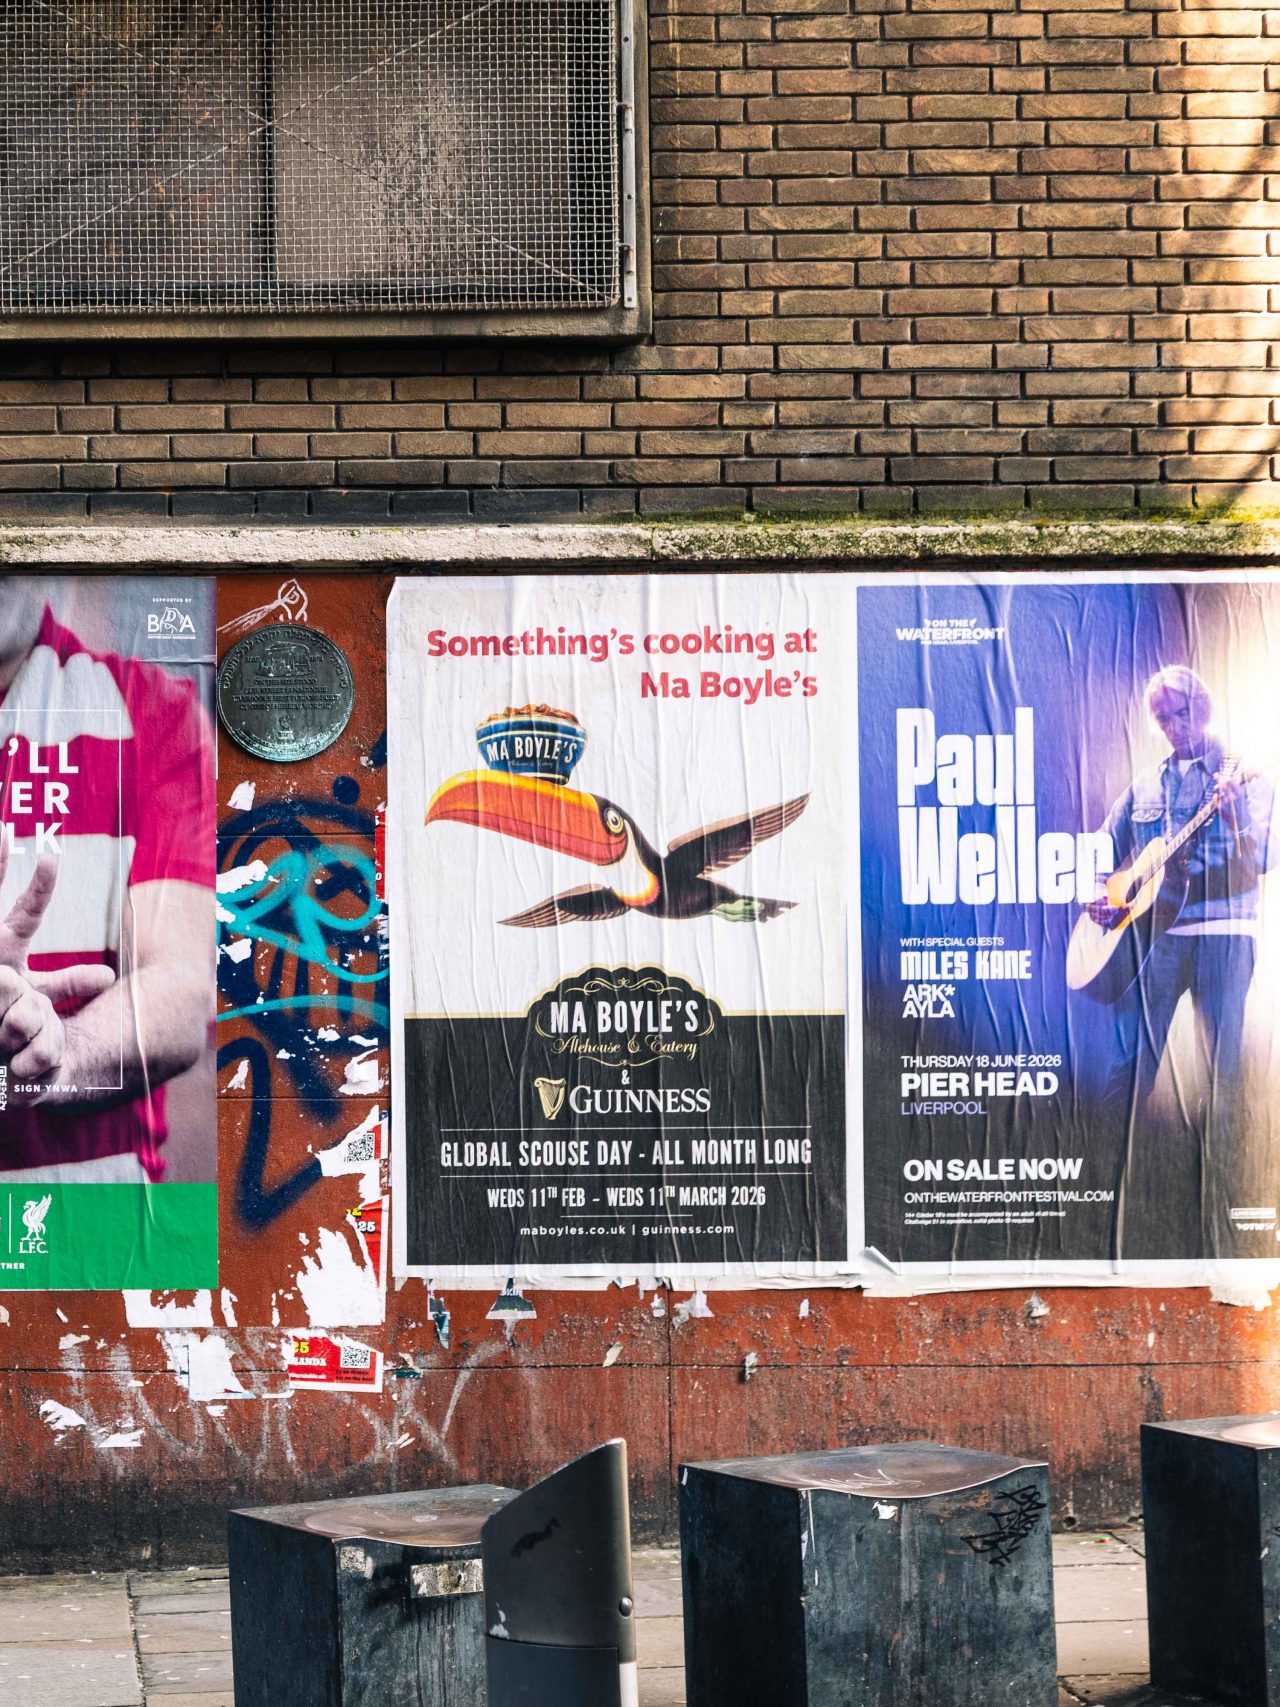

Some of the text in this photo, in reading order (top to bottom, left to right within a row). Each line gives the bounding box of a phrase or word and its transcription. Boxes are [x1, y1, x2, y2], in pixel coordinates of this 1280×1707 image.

[895, 627, 1006, 641] WATERFRONT
[931, 618, 968, 628] ON THE
[427, 625, 818, 662] Something's cooking at
[640, 670, 818, 705] Ma Boyle's
[486, 736, 577, 764] MA BOYLE'S
[896, 706, 1035, 806] Paul
[897, 805, 1114, 905] Weller
[900, 937, 1005, 947] WITH SPECIAL GUESTS
[900, 950, 1032, 981] MILES KANE
[550, 1000, 699, 1033] MA BOYLE'S
[902, 1000, 955, 1019] AYLA
[551, 1035, 621, 1054] Alehouse
[645, 1034, 698, 1061] Eatery
[901, 1054, 1062, 1068] THURSDAY 18 JUNE 2026
[13, 1084, 41, 1093] SIGN
[45, 1084, 78, 1093] YNWA
[621, 1069, 630, 1085] &
[901, 1072, 1059, 1098] PIER HEAD
[569, 1085, 711, 1114] GUINNESS
[901, 1101, 988, 1116] LIVERPOOL
[440, 1141, 512, 1167] GLOBAL
[518, 1140, 590, 1166] SCOUSE
[597, 1140, 633, 1166] DAY
[652, 1140, 685, 1165] ALL
[691, 1139, 756, 1165] MONTH
[763, 1139, 812, 1164] LONG
[903, 1158, 1083, 1181] ON SALE NOW
[487, 1188, 525, 1208] WEDS
[531, 1186, 558, 1208] 11TH
[562, 1187, 586, 1207] FEB
[606, 1187, 644, 1207] WEDS
[649, 1185, 675, 1207] 11TH
[679, 1186, 726, 1206] MARCH
[731, 1185, 766, 1206] 2026
[904, 1190, 1115, 1204] ONTHEWATERFRONTFESTIVAL.COM
[356, 1221, 376, 1233] 25
[520, 1225, 626, 1237] maboyles.co.uk
[642, 1224, 734, 1236] guinness.com
